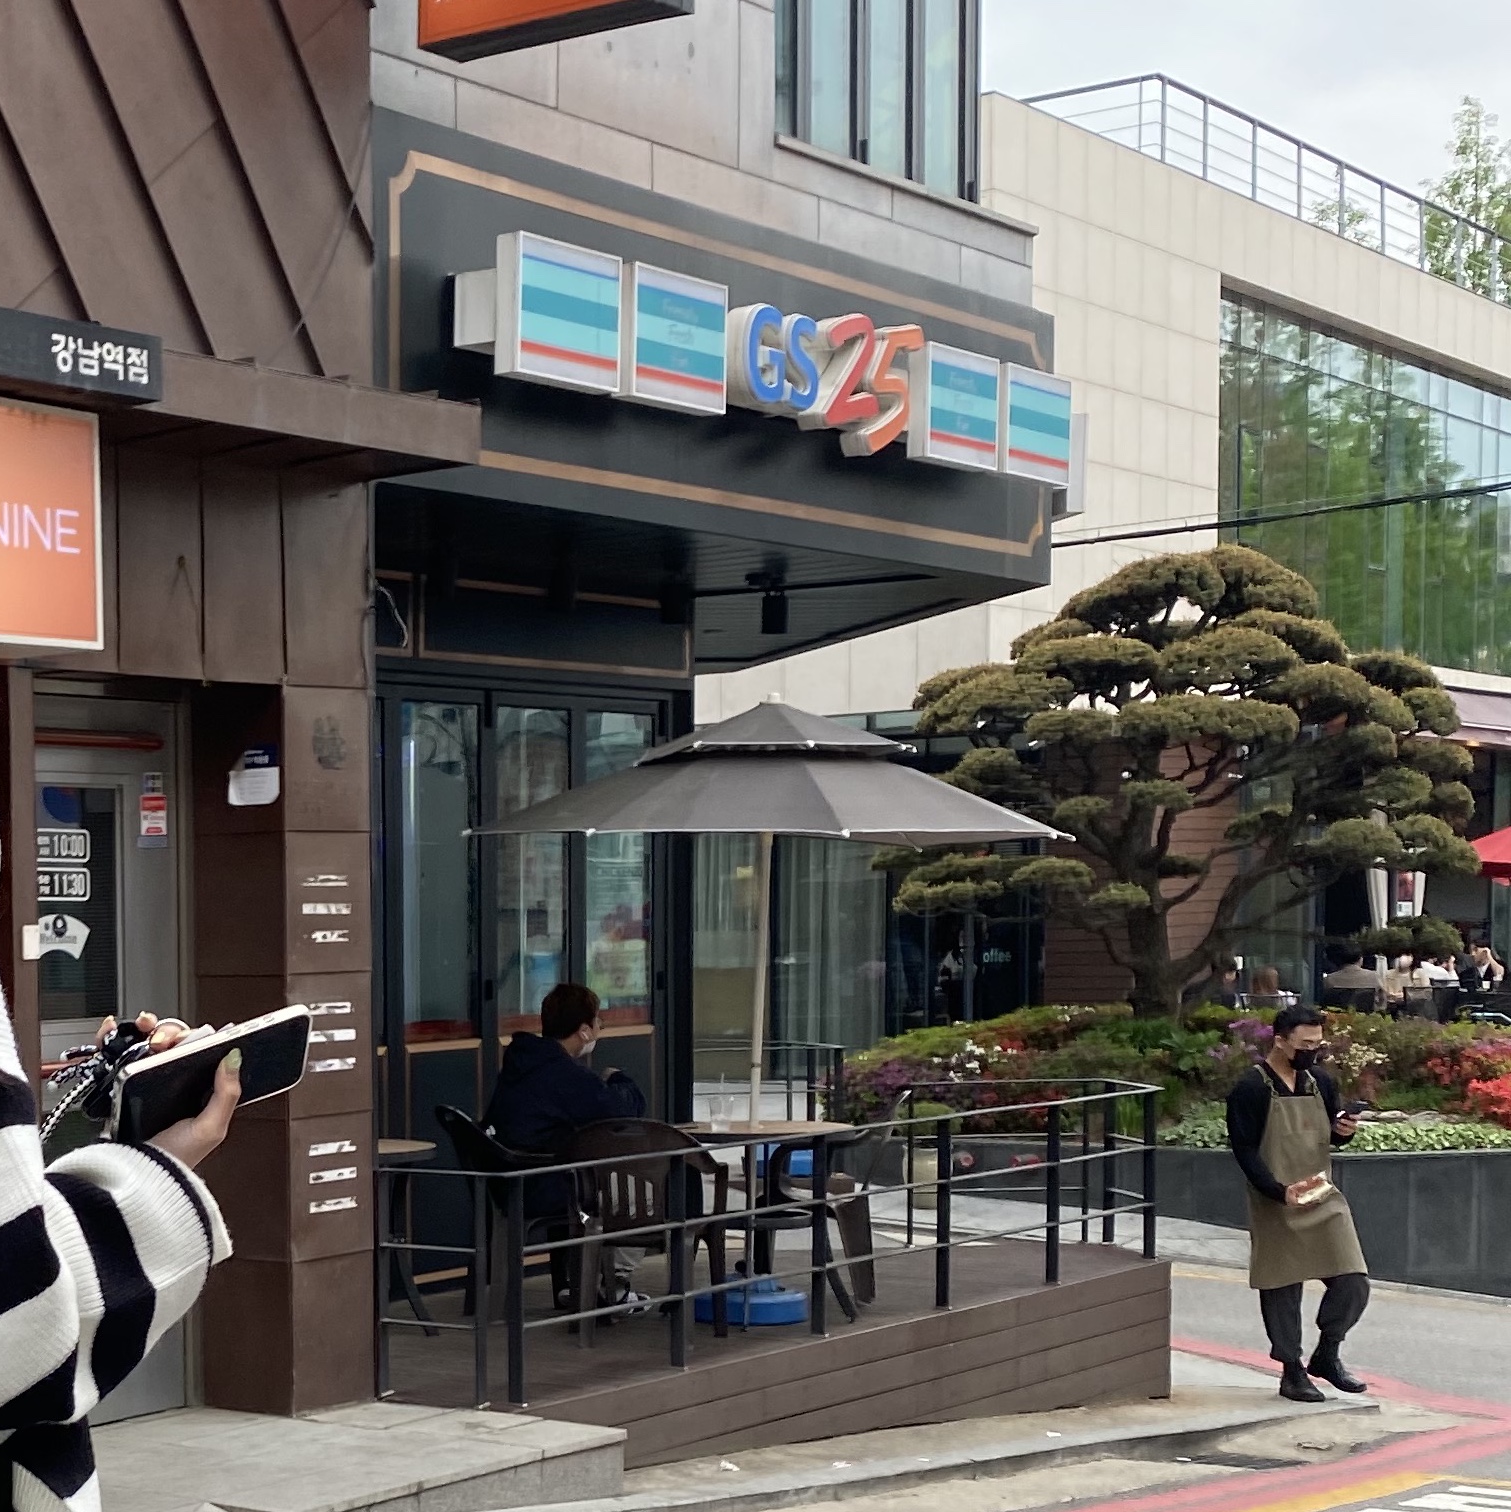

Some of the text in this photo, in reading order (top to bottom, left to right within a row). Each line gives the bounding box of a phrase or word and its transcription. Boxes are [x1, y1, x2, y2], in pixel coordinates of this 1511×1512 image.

[50, 333, 150, 385] 강남역점
[747, 303, 925, 456] GS25
[53, 834, 86, 857] 10:00
[53, 873, 86, 896] 11:30
[982, 948, 1012, 963] offee
